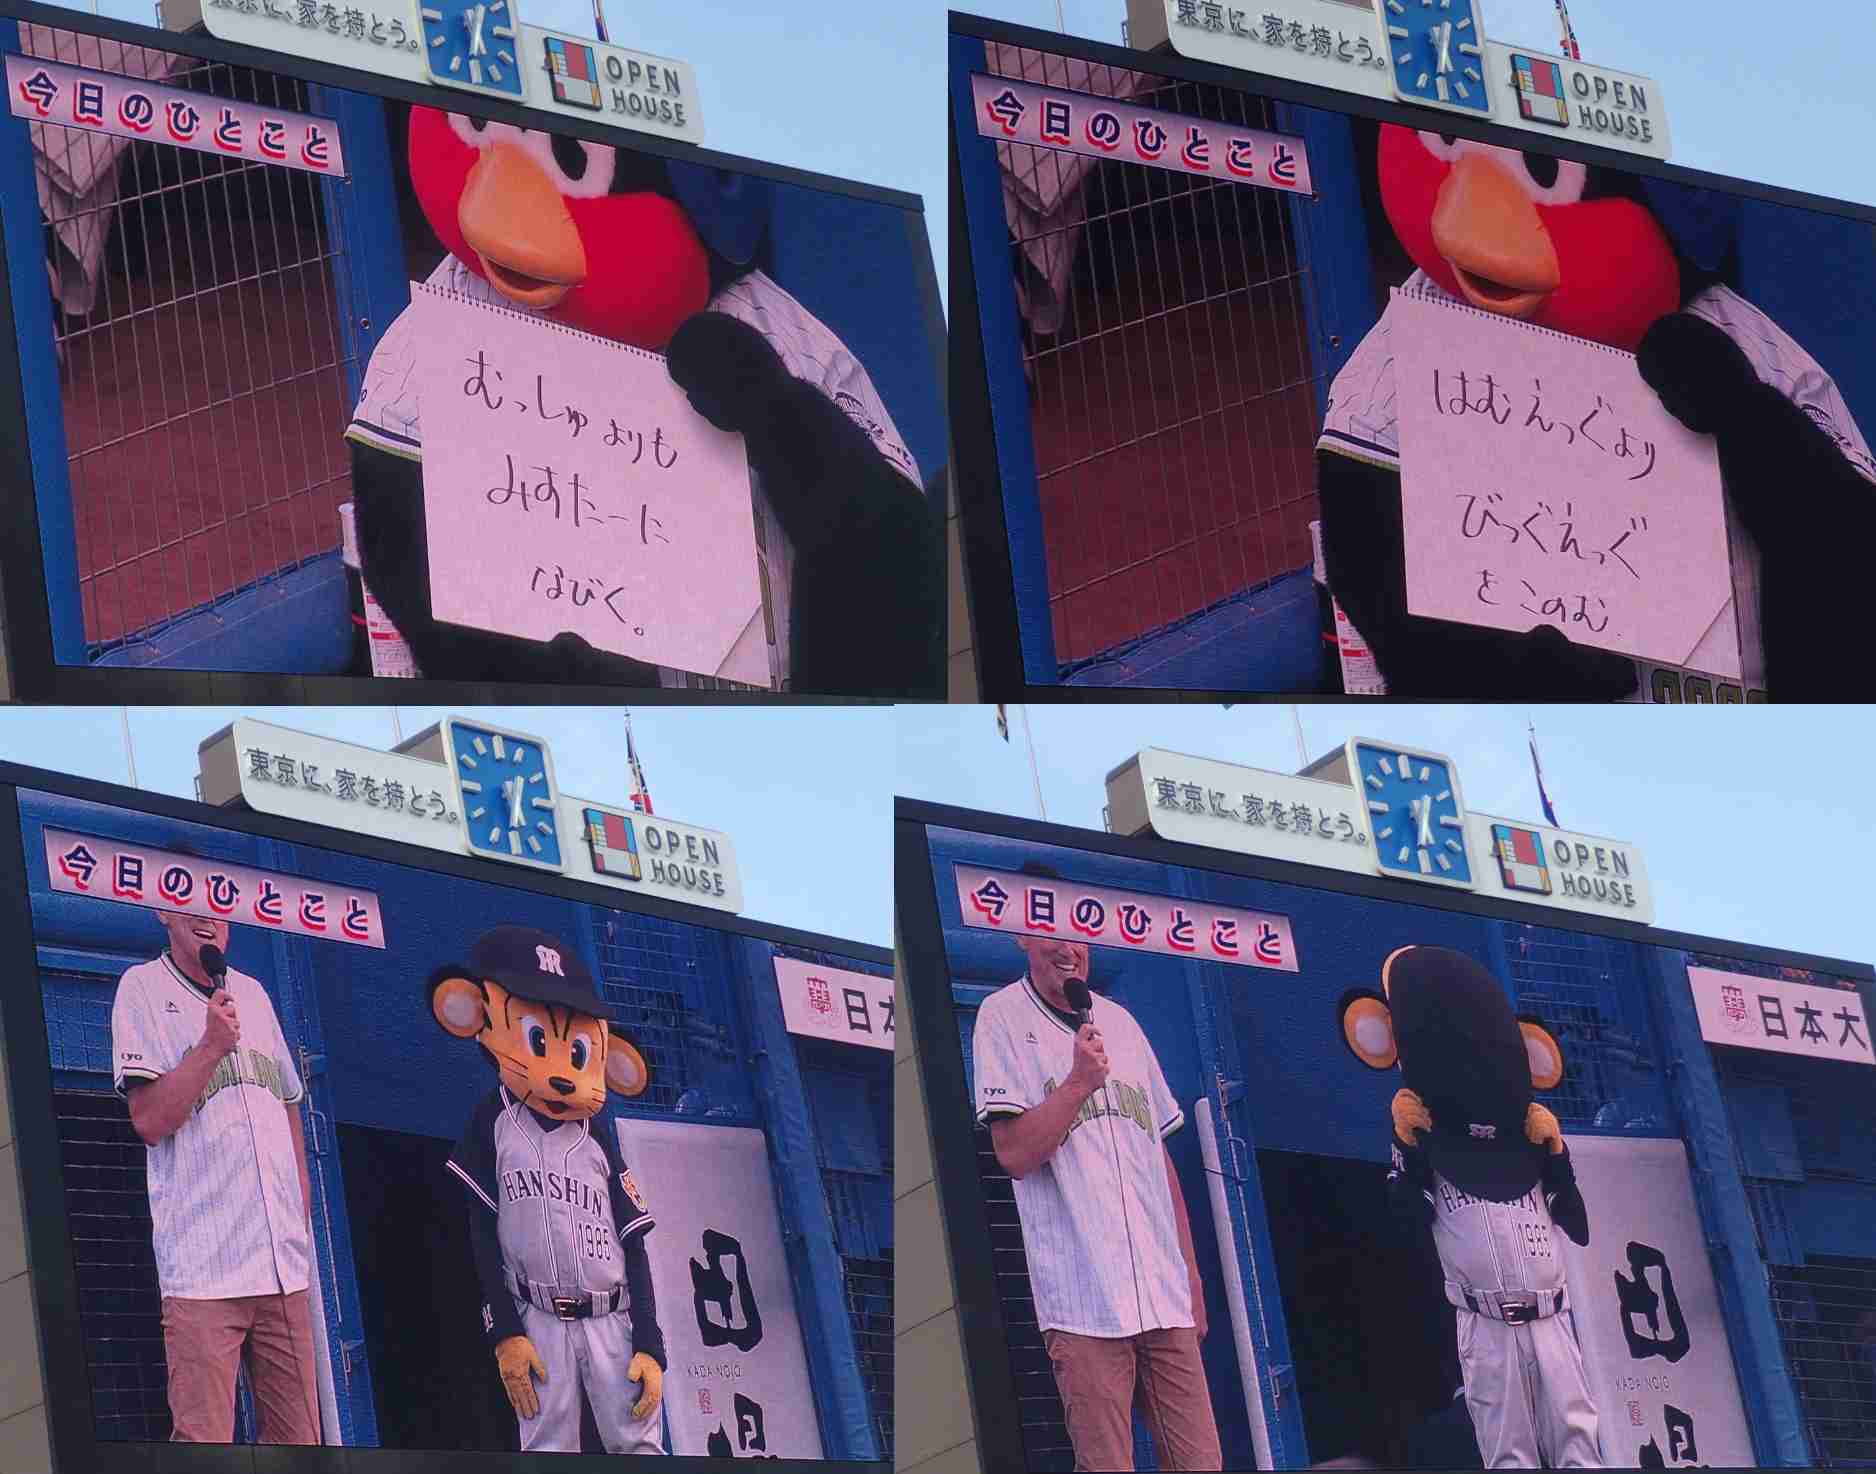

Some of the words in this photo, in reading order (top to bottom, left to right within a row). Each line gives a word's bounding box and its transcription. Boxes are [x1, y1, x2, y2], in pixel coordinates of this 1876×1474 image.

[606, 56, 680, 95] OPEN
[1573, 72, 1647, 112] OPEN
[19, 70, 329, 168] 今日のひとこと
[611, 88, 685, 127] HOUSE
[1578, 105, 1653, 143] HOUSE
[986, 89, 1297, 186] 今日のひとこと
[645, 826, 719, 865] OPEN
[1554, 840, 1629, 876] OPEN
[60, 844, 369, 940] 今日のひとこと
[650, 858, 726, 897] HOUSE
[1560, 872, 1637, 908] HOUSE
[971, 878, 1283, 965] 今日のひとこと
[502, 1168, 602, 1217] HANSHIN
